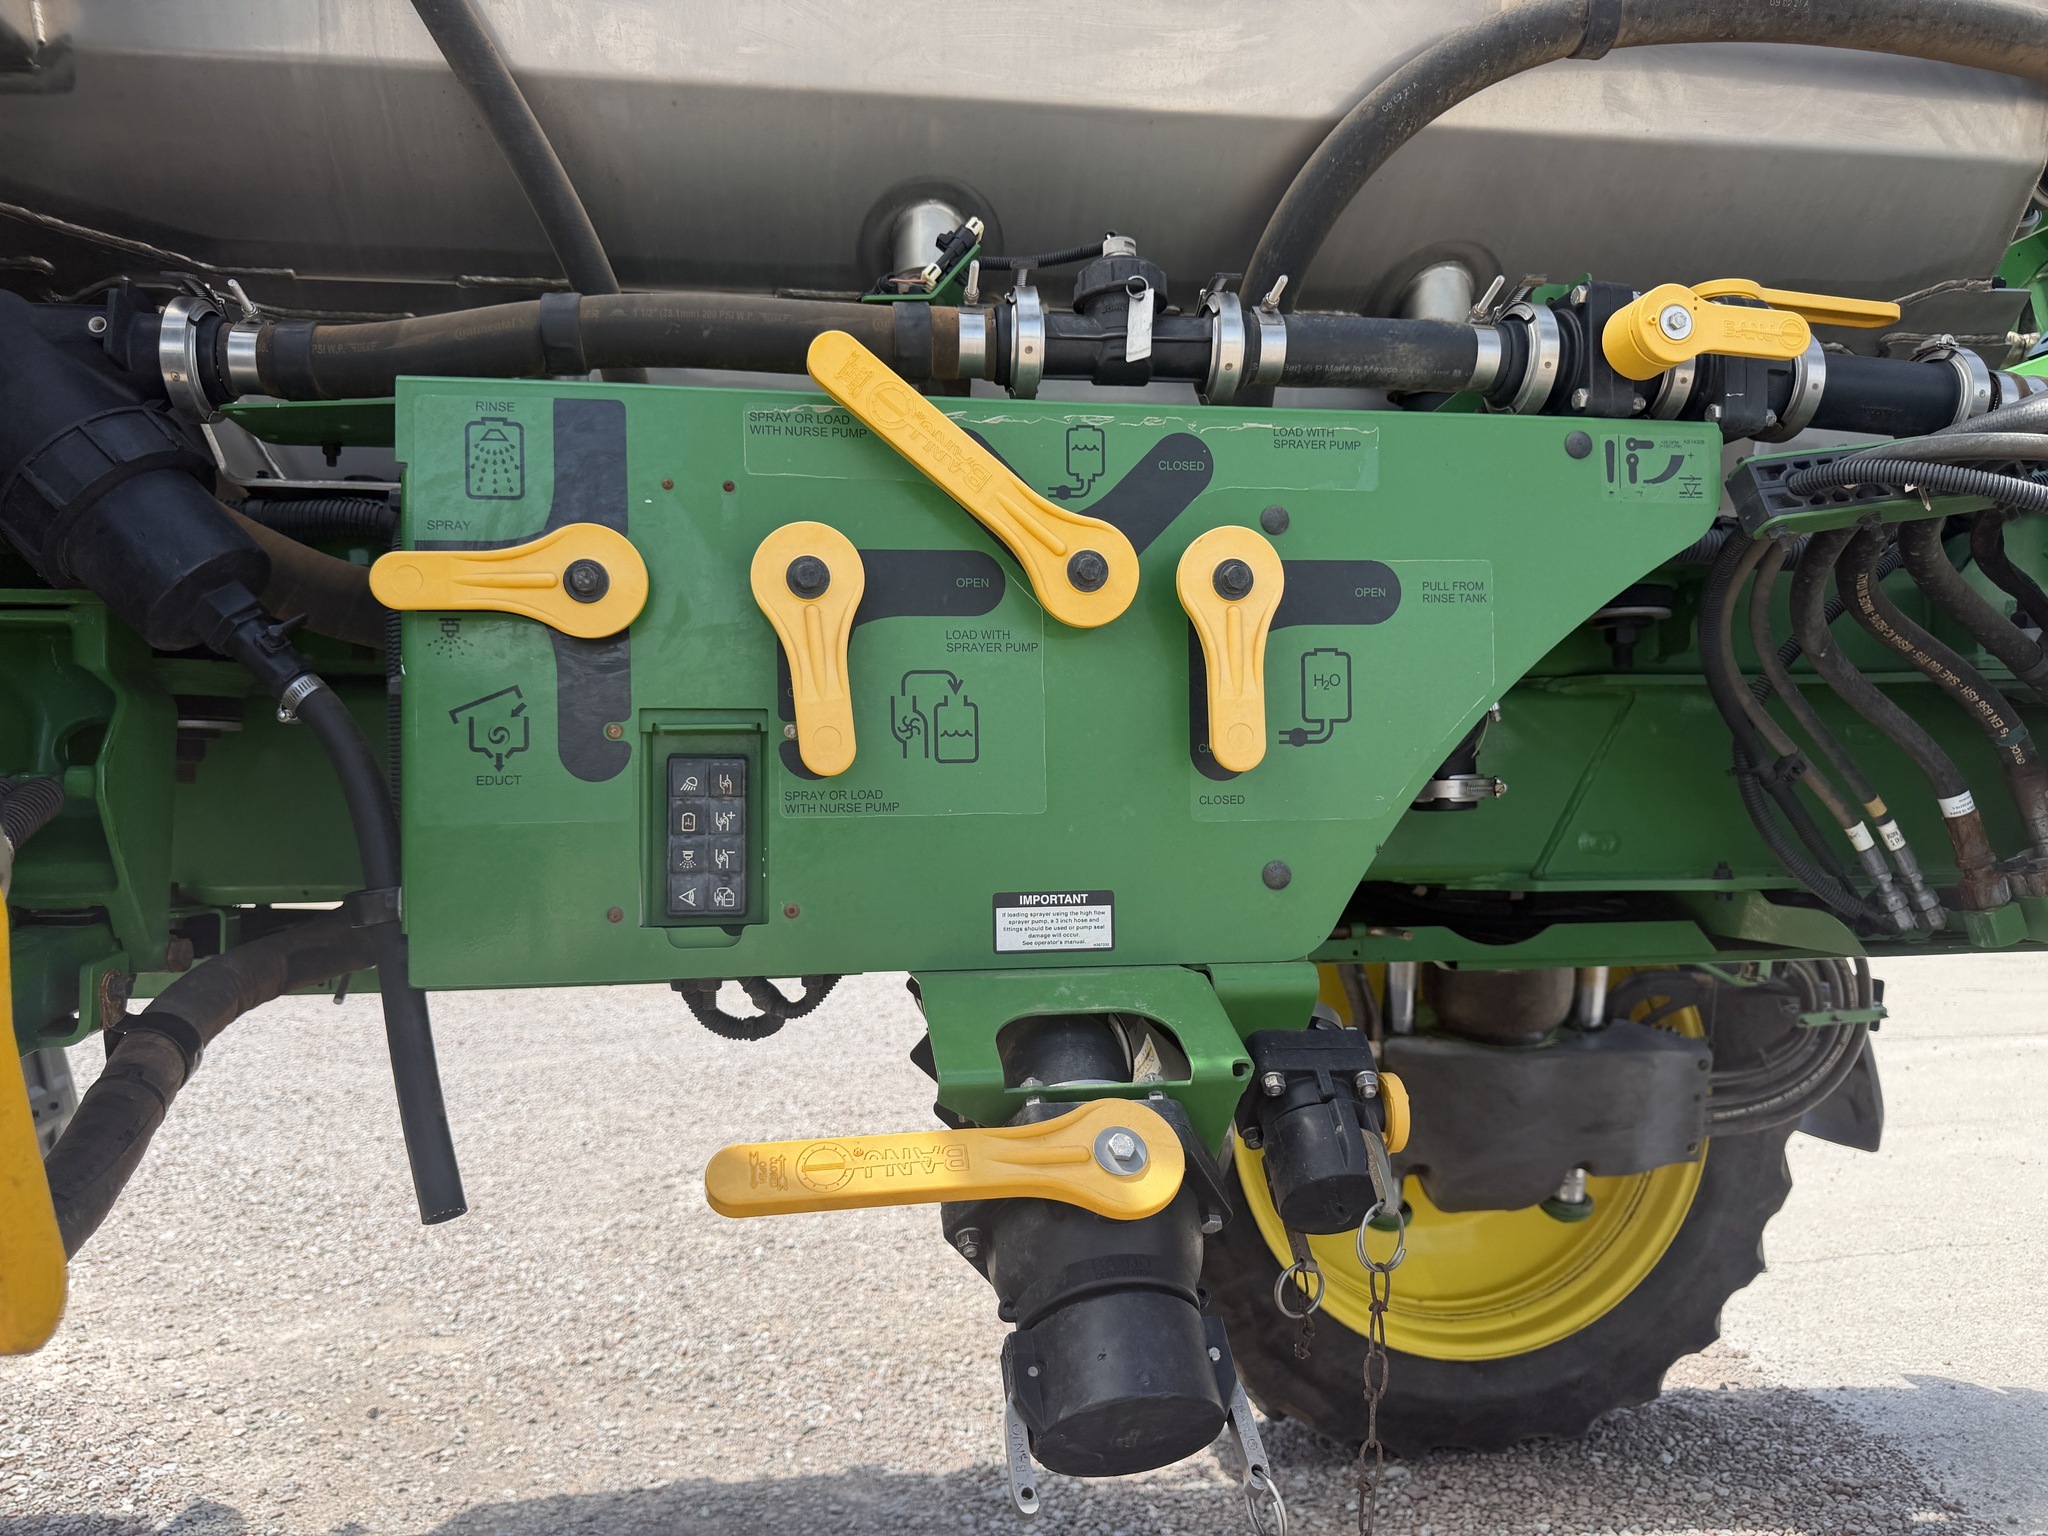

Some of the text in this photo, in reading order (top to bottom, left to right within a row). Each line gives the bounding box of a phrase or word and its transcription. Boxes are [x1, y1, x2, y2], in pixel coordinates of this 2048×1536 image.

[1324, 363, 1351, 373] Made
[1363, 364, 1398, 374] Mexico
[475, 401, 515, 412] RINSE
[749, 411, 850, 425] SPRAY OR LOAD
[749, 424, 868, 439] WITH NURSE PUMP
[1273, 427, 1335, 438] LOAD WITH
[1273, 439, 1361, 451] SPRAYER PUMP
[1158, 460, 1205, 471] CLOSED
[426, 519, 472, 531] SPRAY
[956, 577, 990, 588] OPEN
[1422, 581, 1484, 591] PULL FROM
[1354, 587, 1386, 598] OPEN
[1422, 593, 1488, 603] RINSE TANK
[1858, 596, 1876, 615] MADE
[945, 630, 1011, 640] LOAD WITH
[946, 642, 1039, 653] SPRAYER PUMP
[1926, 660, 1943, 675] 100
[1941, 669, 1961, 687] SAE
[1960, 684, 1981, 703] 4SH
[1977, 699, 1995, 717] 856
[1987, 712, 2005, 730] EN
[476, 775, 522, 786] EDUCT
[784, 789, 883, 801] SPRAY OR LOAD
[1198, 795, 1246, 805] CLOSED
[784, 801, 901, 814] WITH NURSE PUMP
[1019, 893, 1089, 905] IMPORTANT
[1011, 1423, 1029, 1473] BANJO
